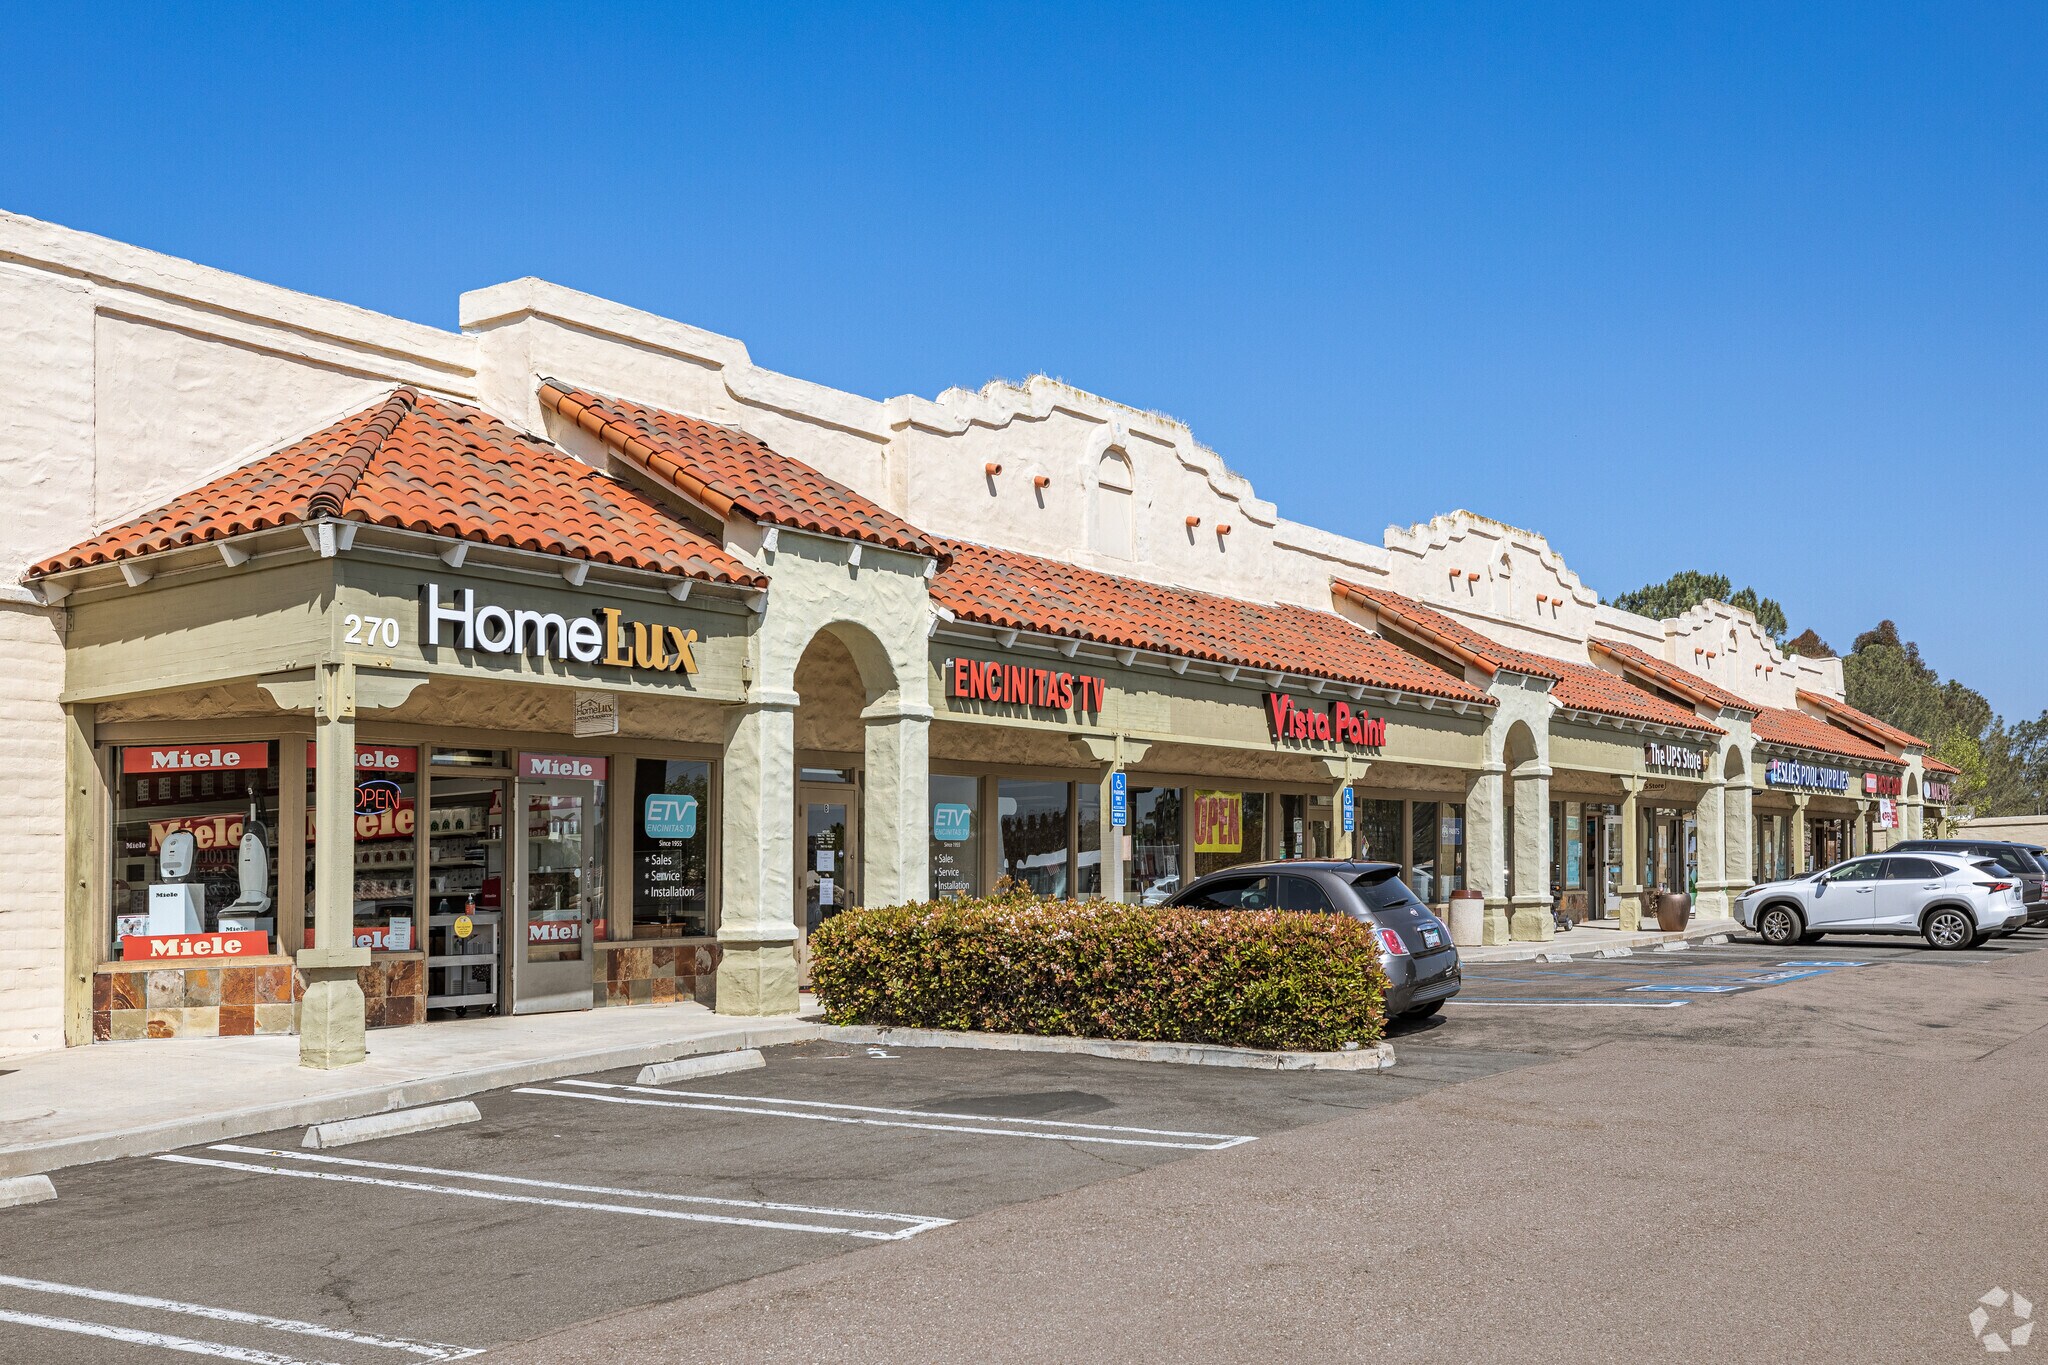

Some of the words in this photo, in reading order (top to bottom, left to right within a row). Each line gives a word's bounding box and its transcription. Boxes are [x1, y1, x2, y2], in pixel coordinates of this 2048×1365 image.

[344, 614, 400, 648] 270
[954, 657, 1073, 709] ENCINITAS
[1080, 674, 1105, 712] TV
[1269, 692, 1332, 742] Vista
[1336, 701, 1387, 747] Paint
[151, 749, 240, 769] Miele
[1650, 742, 1665, 765] The
[1666, 745, 1682, 768] UPS
[1682, 747, 1702, 770] Store
[531, 758, 593, 776] Miele
[1800, 765, 1818, 787] POOL
[1819, 767, 1850, 790] SUPPLIES
[354, 787, 400, 809] OPEN
[647, 800, 698, 822] ETV
[935, 808, 972, 826] ETV
[1194, 796, 1240, 845] OPEN
[647, 824, 684, 832] ENCINITAS
[685, 824, 696, 832] TV
[651, 854, 672, 866] Sales
[938, 854, 954, 863] Sales
[651, 870, 681, 881] Service
[938, 868, 960, 876] Service
[651, 886, 695, 898] Installation
[938, 881, 970, 890] Installation
[529, 924, 582, 941] Miel
[150, 937, 242, 957] Miele
